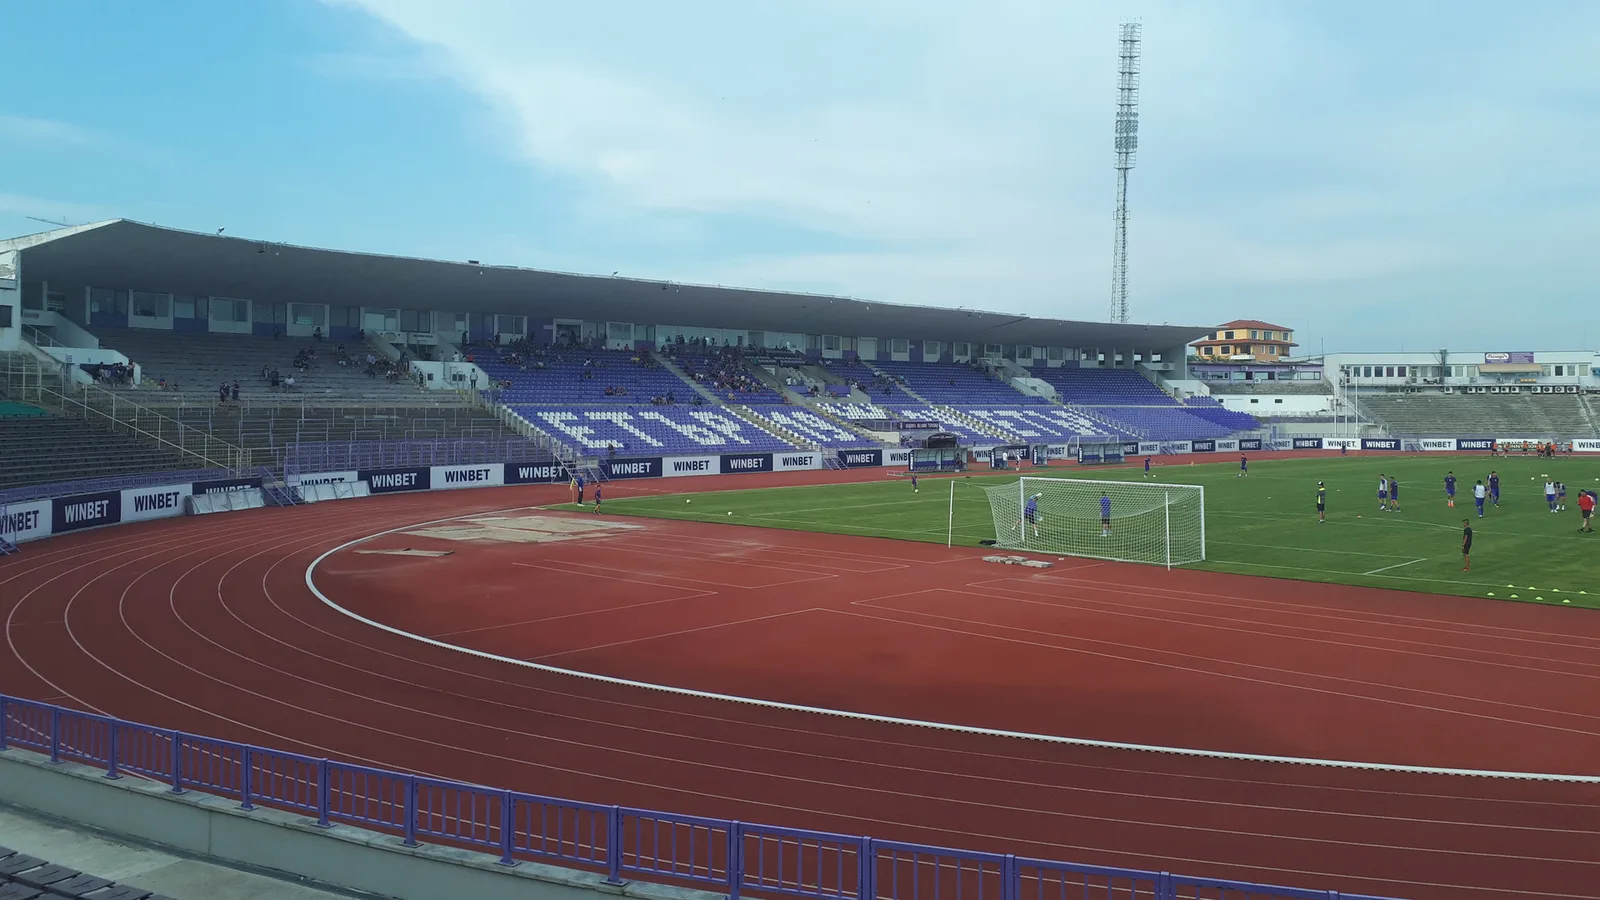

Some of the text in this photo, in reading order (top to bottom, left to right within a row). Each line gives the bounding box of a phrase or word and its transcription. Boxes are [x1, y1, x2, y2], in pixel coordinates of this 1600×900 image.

[1124, 444, 1136, 452] NBET
[1194, 442, 1213, 450] WINBET
[1366, 440, 1396, 448] WINBET
[1578, 441, 1600, 449] WINB
[782, 456, 813, 467] WINBET
[846, 453, 875, 464] WINBET
[889, 452, 909, 462] WINB
[611, 462, 651, 475] WINBET
[673, 460, 710, 472] WINBET
[729, 458, 764, 469] WINBET
[444, 468, 491, 482] WINBET
[518, 466, 564, 479] WINBET
[371, 472, 418, 488] WINBET
[134, 491, 180, 512] WINBET
[64, 500, 109, 523] WINBET
